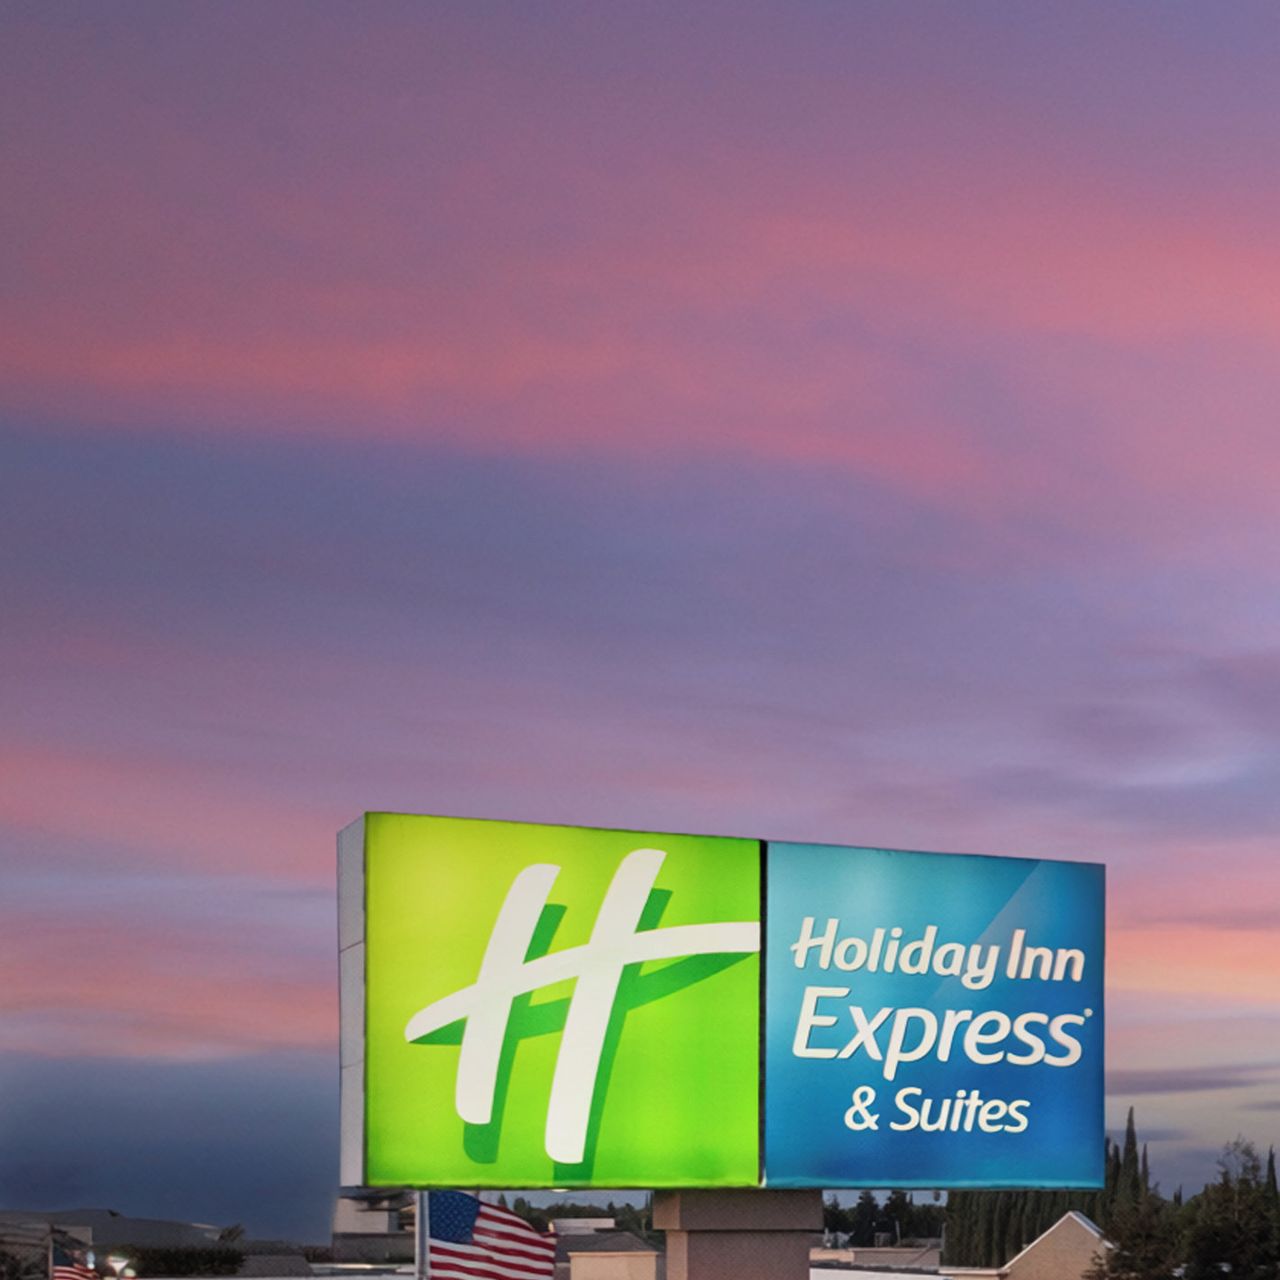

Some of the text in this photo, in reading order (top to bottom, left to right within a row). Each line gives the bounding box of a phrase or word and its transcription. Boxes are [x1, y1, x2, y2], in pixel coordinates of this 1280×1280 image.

[790, 916, 1086, 990] Holiday Inn
[792, 985, 1086, 1081] Express
[844, 1085, 1031, 1133] & Suites
